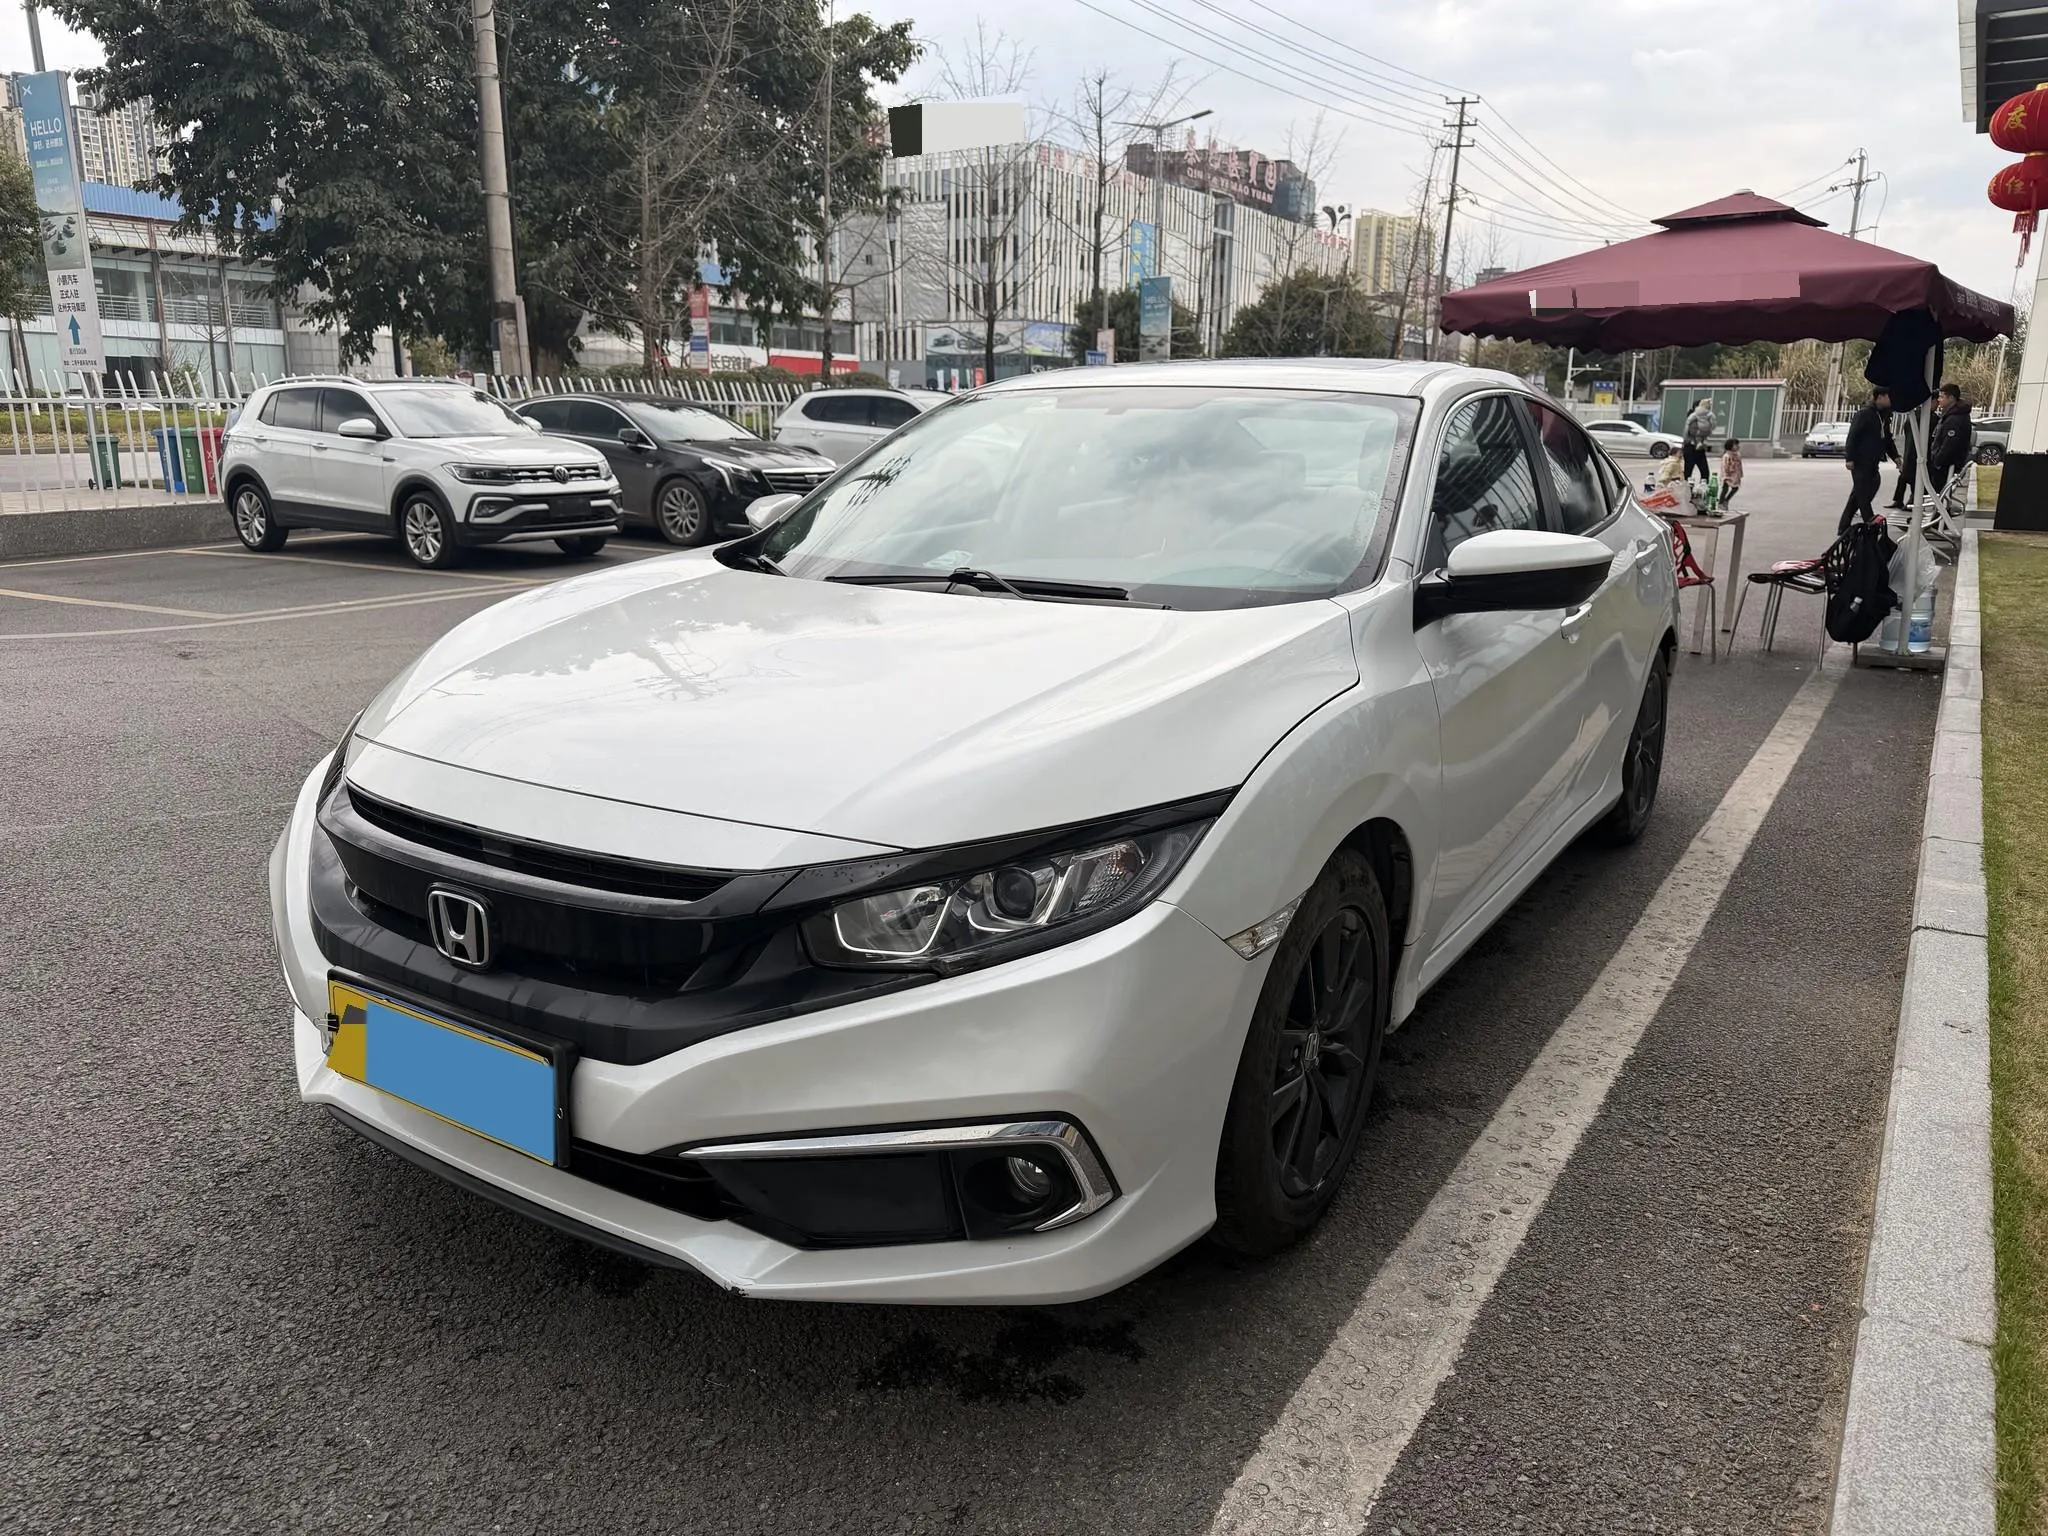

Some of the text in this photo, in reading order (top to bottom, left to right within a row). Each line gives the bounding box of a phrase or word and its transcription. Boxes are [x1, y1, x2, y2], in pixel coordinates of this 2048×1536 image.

[2004, 103, 2027, 131] 度
[30, 117, 62, 137] HELLO
[1251, 187, 1274, 204] YUAN
[59, 288, 80, 300] 正式入驻
[57, 301, 87, 313] 达州天马集团
